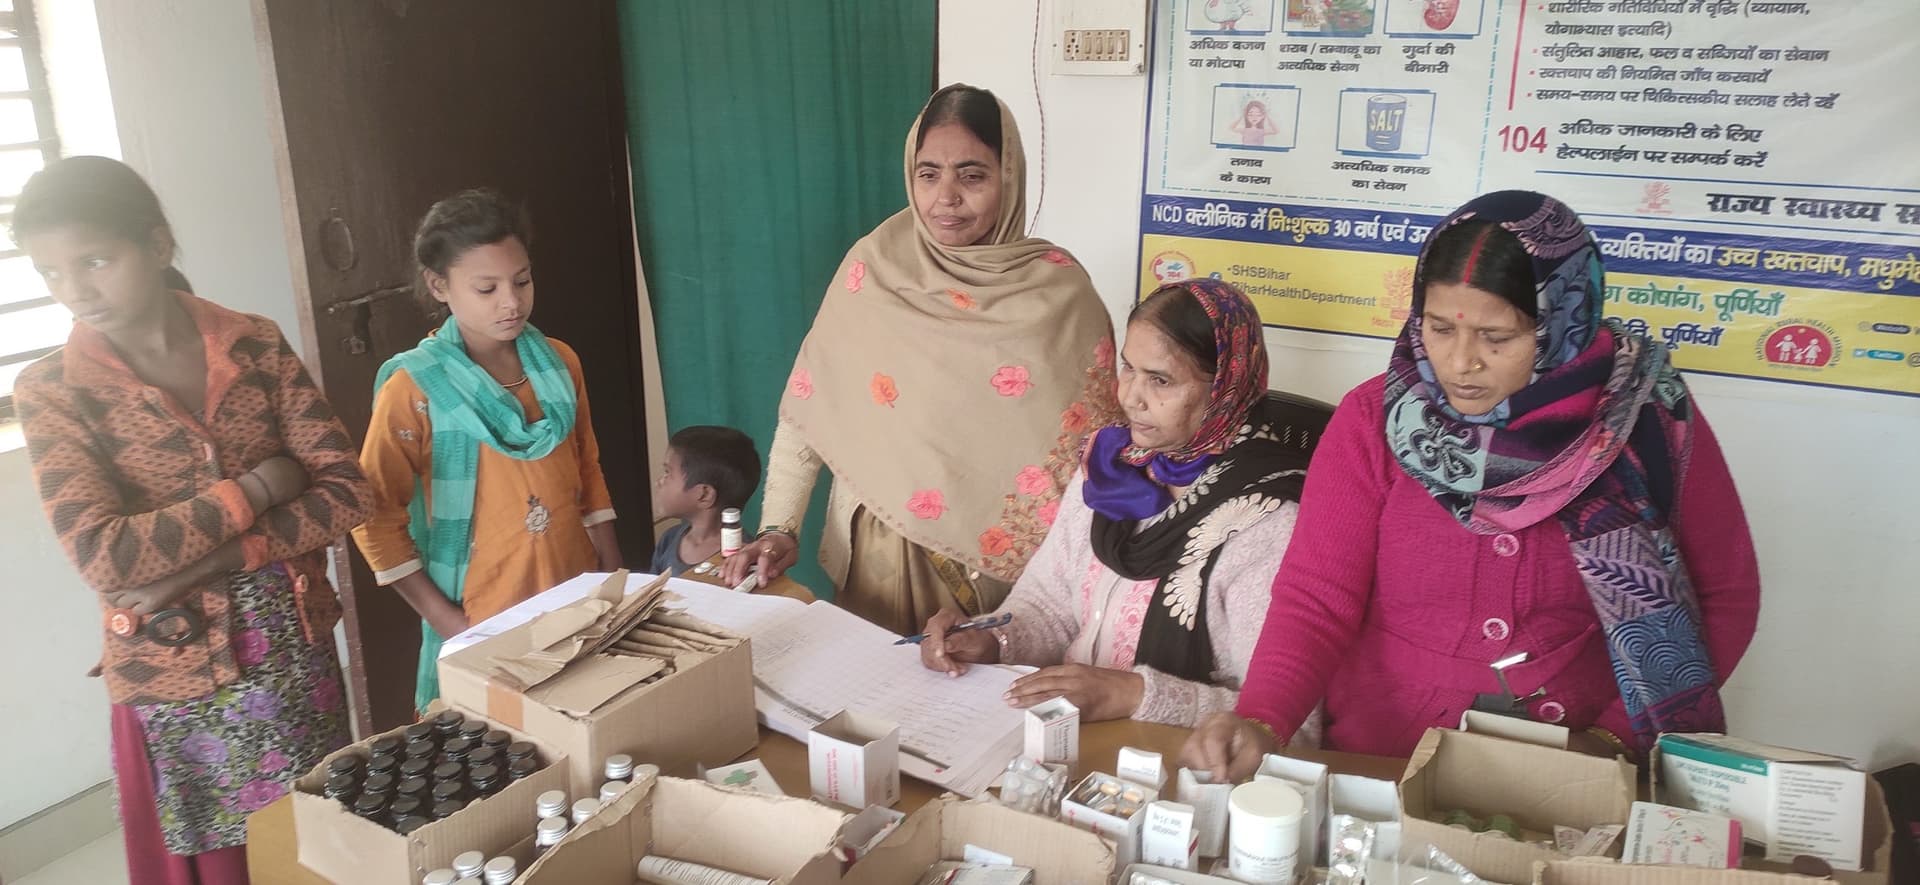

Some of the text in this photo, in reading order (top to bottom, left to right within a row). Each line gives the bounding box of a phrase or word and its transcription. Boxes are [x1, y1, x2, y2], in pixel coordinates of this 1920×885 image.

[1544, 20, 1672, 40] योगाभ्यास इत्यादि)
[1189, 37, 1266, 51] अधिक वजन
[1280, 43, 1308, 53] शराब
[1363, 45, 1381, 55] का
[1435, 42, 1456, 55] की
[1542, 42, 1595, 62] संतुलित
[1597, 46, 1643, 59] आहार,
[1650, 48, 1680, 59] फल
[1682, 48, 1694, 59] व
[1758, 49, 1781, 60] का
[1189, 56, 1246, 69] या मोटापा
[1278, 59, 1360, 72] अत्यधिक सेवन
[1405, 60, 1449, 73] बीमारी
[1539, 67, 1593, 79] रक्तचाप
[1596, 65, 1617, 80] की
[1620, 65, 1678, 81] नियमित
[1620, 90, 1641, 102] पर
[1643, 87, 1731, 104] चिकित्सकीय
[1734, 94, 1780, 107] सलाह
[1783, 92, 1812, 108] लेते
[1370, 109, 1403, 131] SALT
[1558, 119, 1763, 142] अधिक जानकारी के लिए
[1498, 125, 1549, 154] 104
[1230, 157, 1264, 168] तनाव
[1556, 143, 1768, 168] हेल्पलाईन पर सम्पर्क करें
[1331, 160, 1432, 176] अत्यधिक नमक
[1219, 171, 1272, 185] के कारण
[1352, 178, 1408, 192] का सेवन
[1706, 193, 1776, 215] राज्य
[1783, 197, 1888, 222] स्वास्थ्य
[1152, 204, 1182, 223] NCD
[1185, 203, 1249, 229] क्लीनिक
[1250, 207, 1267, 231] में
[1333, 220, 1351, 238] 30
[1353, 215, 1381, 239] वर्ष
[1381, 218, 1410, 242] एवं
[1684, 244, 1716, 265] का
[1717, 246, 1760, 267] उच्च
[1231, 264, 1292, 281] SHSBihar
